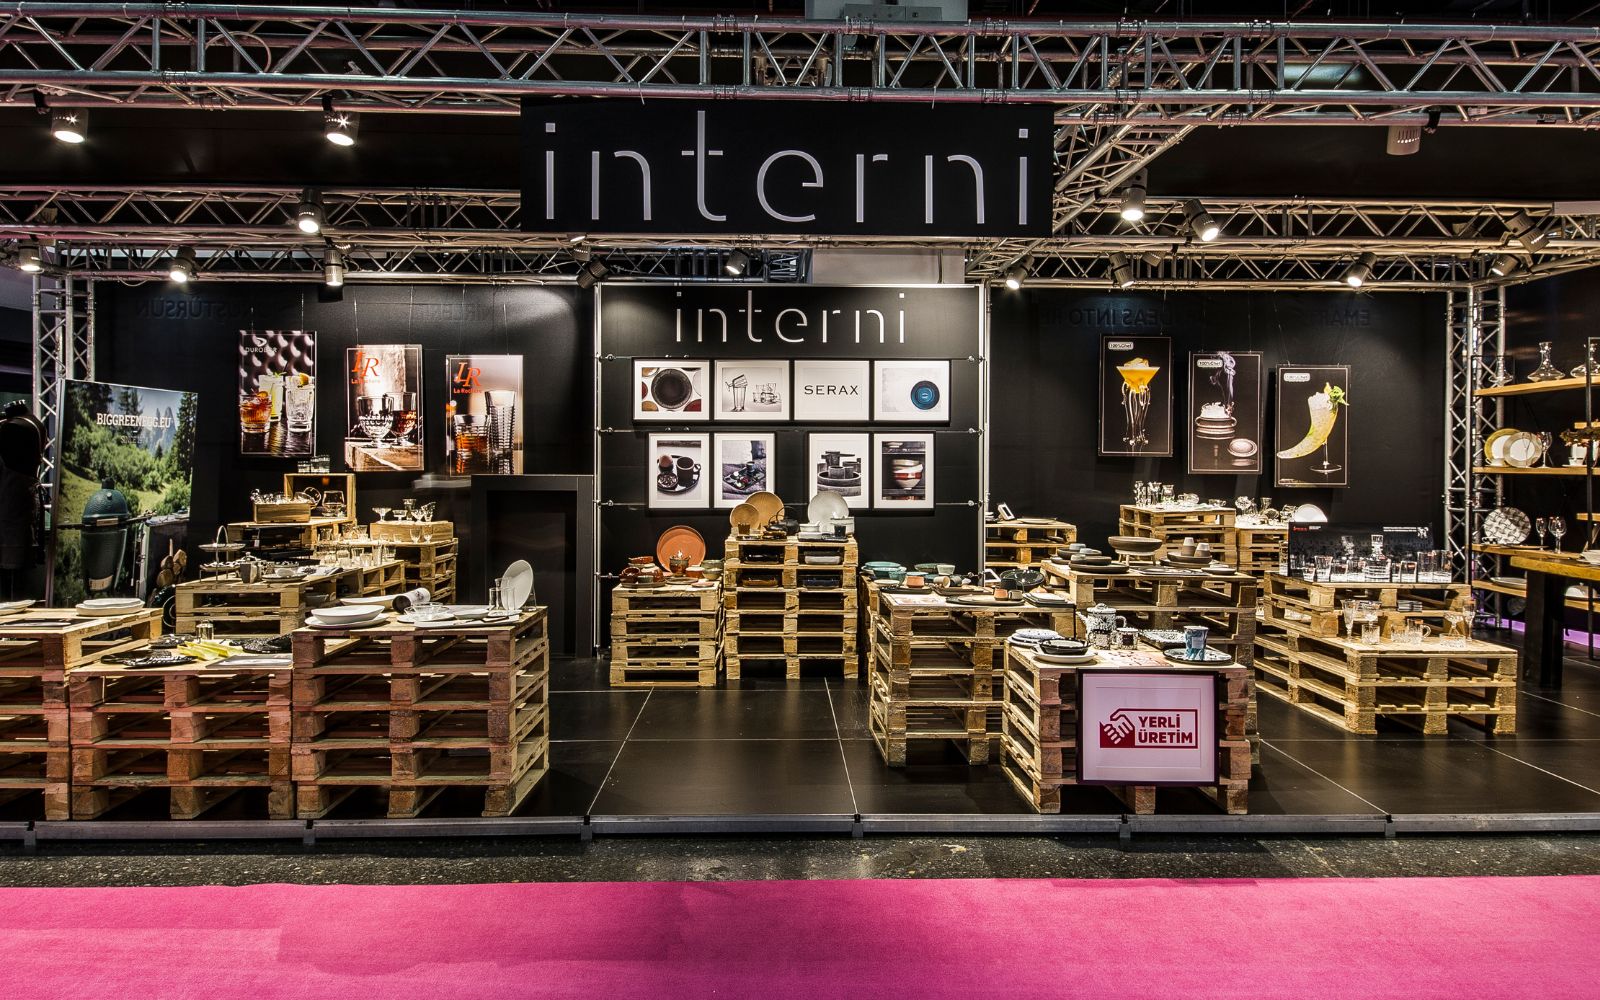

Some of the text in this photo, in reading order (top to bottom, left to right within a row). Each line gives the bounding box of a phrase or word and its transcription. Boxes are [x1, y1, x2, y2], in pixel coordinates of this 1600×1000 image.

[546, 110, 1029, 225] interni
[675, 289, 905, 343] interni
[453, 362, 481, 387] LR
[804, 384, 859, 395] SERAX
[1138, 713, 1181, 728] YERLİ
[1138, 728, 1193, 744] ÜRETİM
